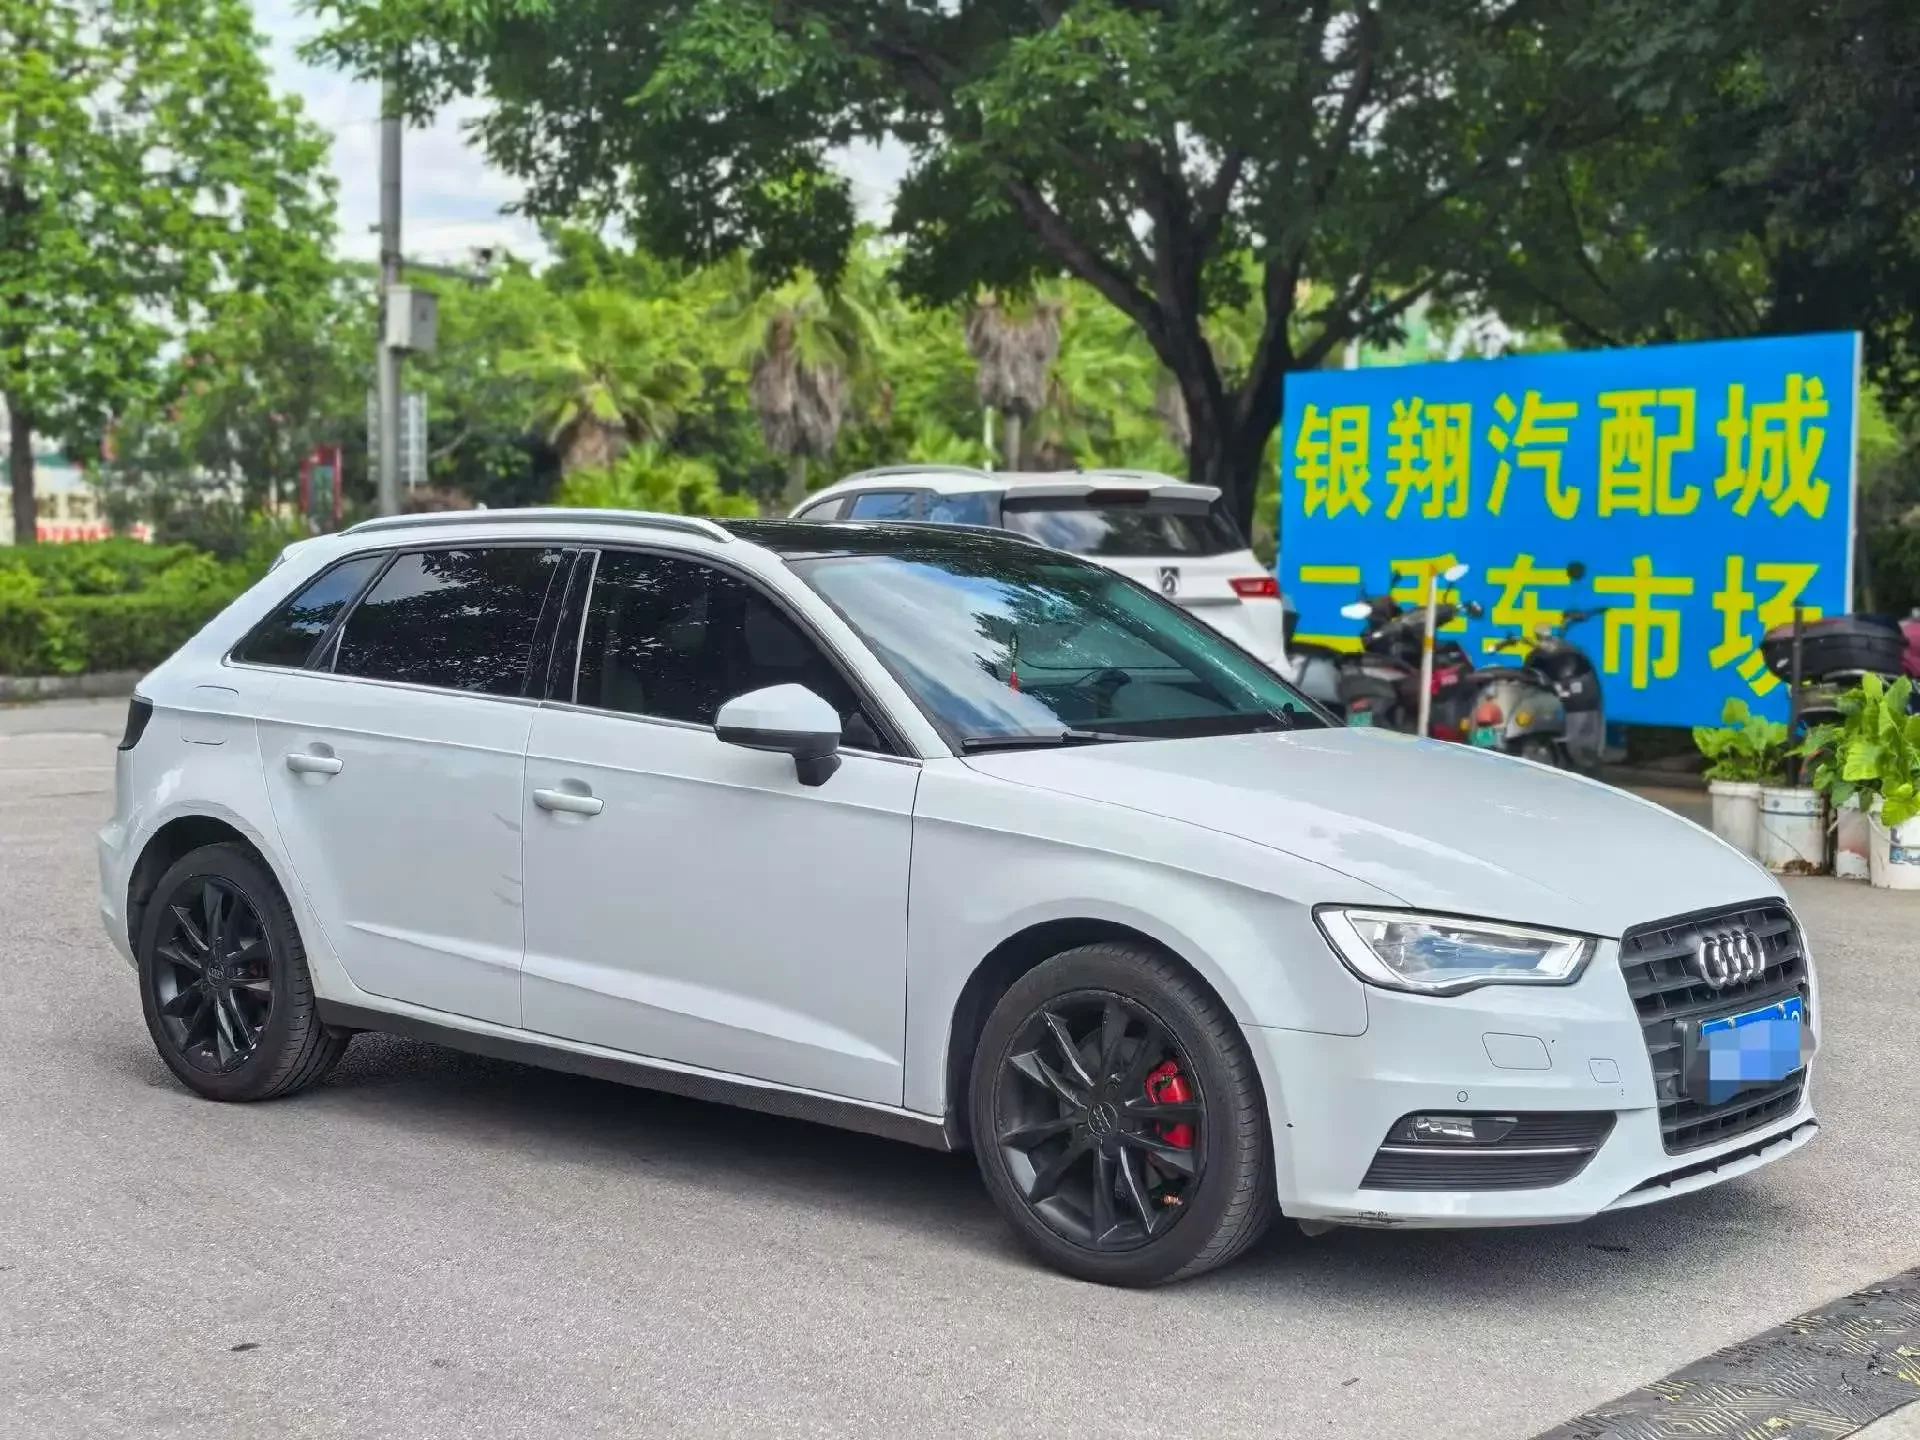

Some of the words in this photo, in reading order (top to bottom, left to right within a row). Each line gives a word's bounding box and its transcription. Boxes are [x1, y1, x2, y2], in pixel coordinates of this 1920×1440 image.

[1295, 374, 1831, 519] 银翔汽配城
